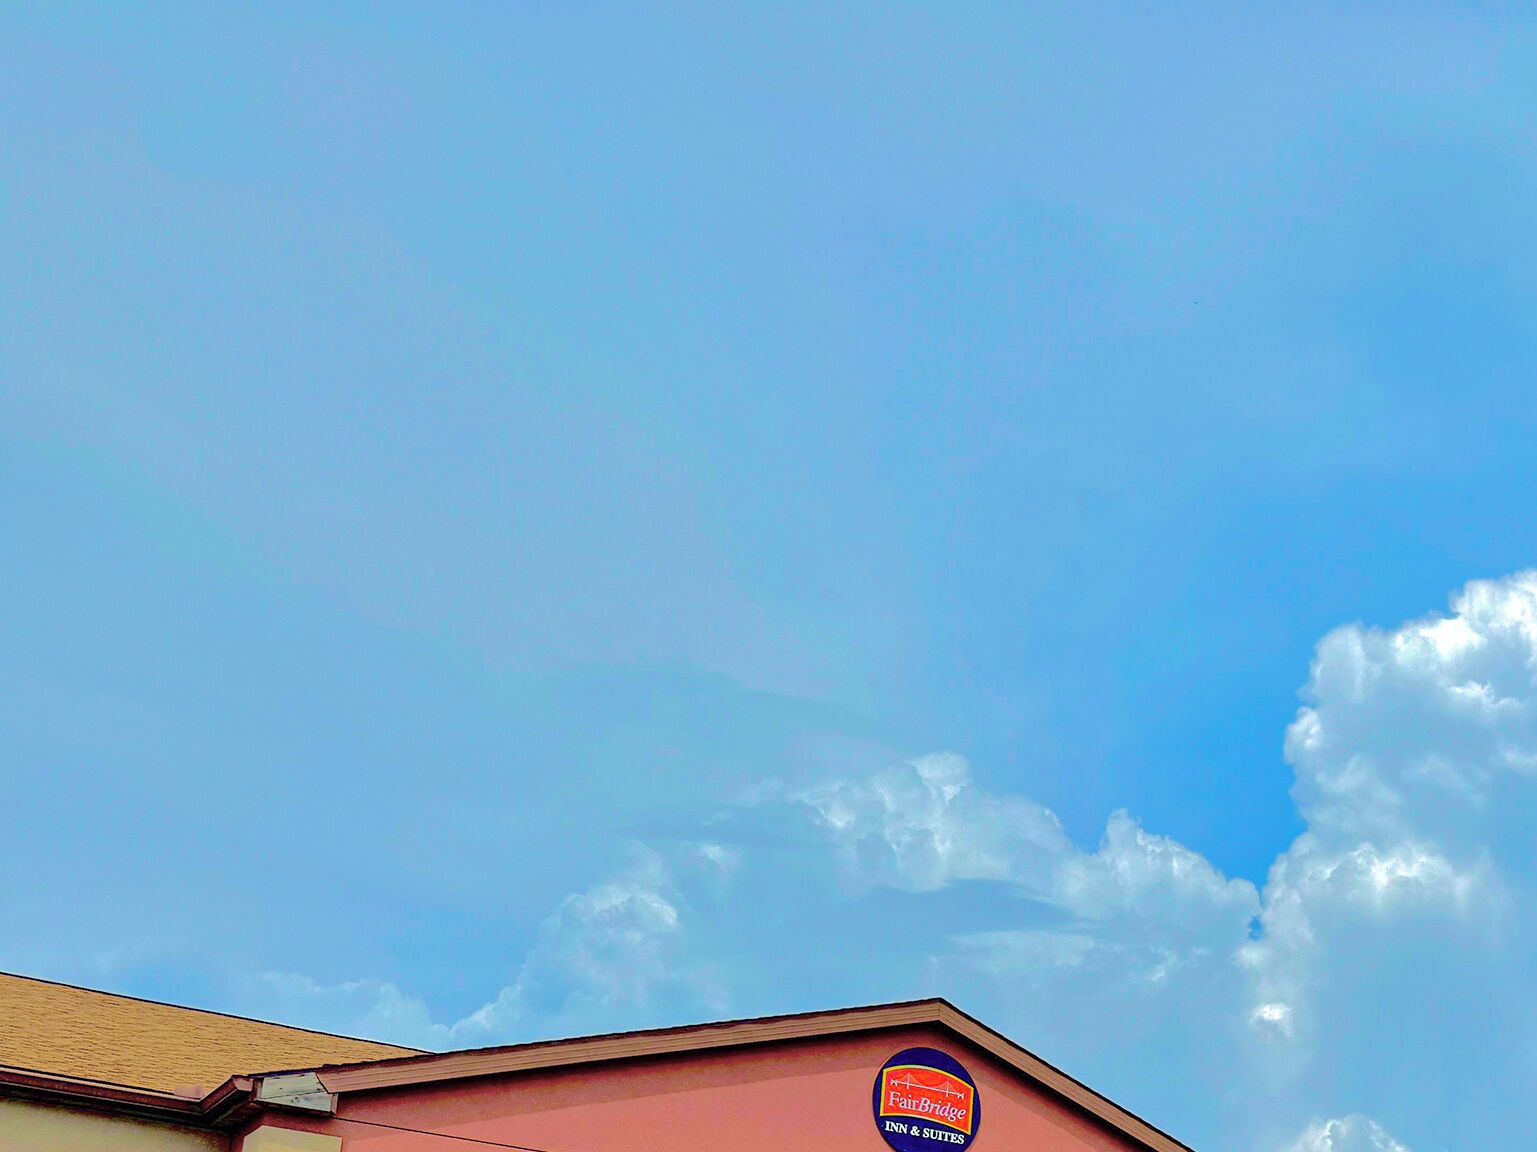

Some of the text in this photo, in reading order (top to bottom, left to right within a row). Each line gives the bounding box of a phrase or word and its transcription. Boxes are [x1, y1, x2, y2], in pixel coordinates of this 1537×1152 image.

[888, 1090, 967, 1122] FairBridge
[885, 1121, 965, 1144] INN & SUITES
